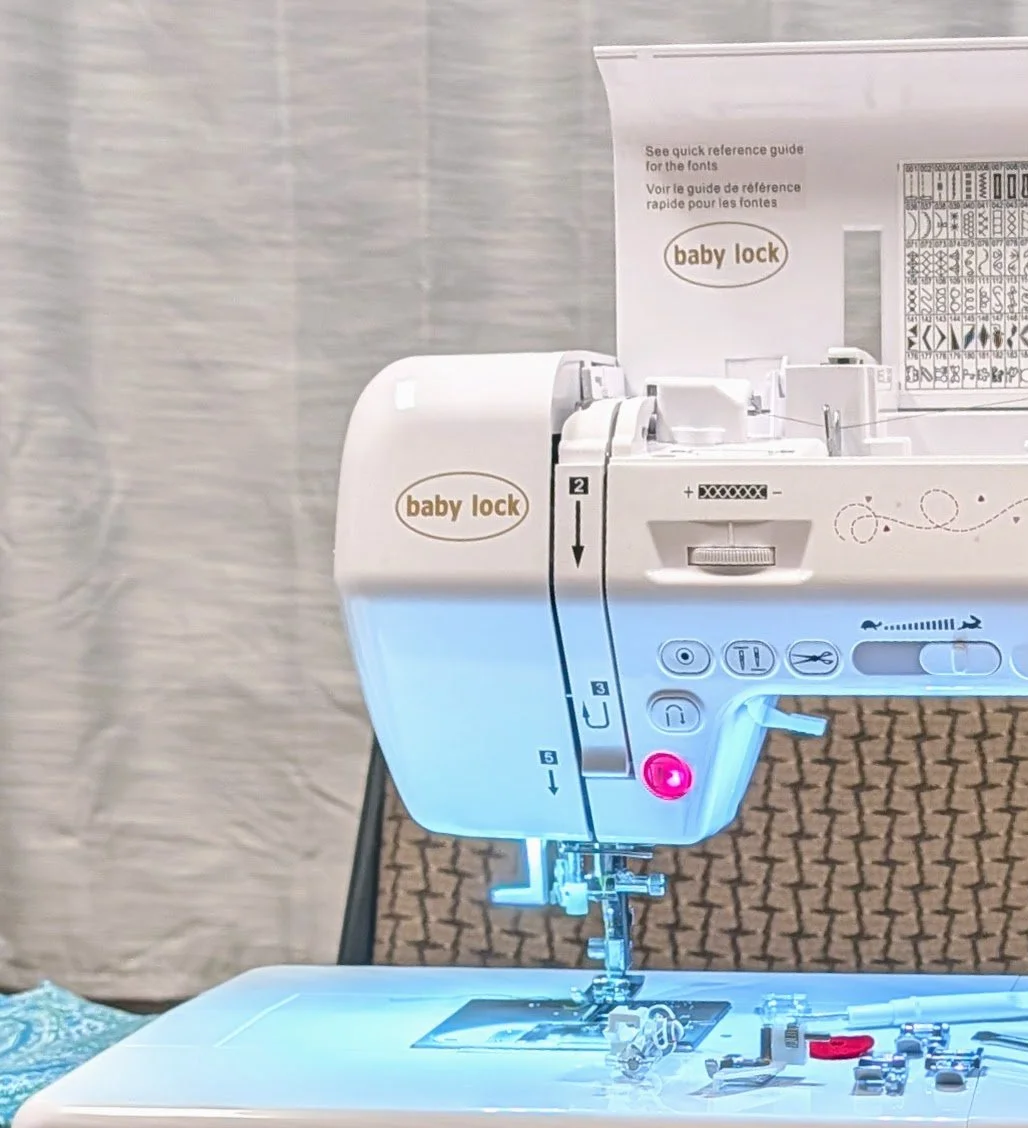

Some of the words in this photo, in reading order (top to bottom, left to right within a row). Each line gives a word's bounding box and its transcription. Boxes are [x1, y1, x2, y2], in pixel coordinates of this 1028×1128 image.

[645, 145, 669, 157] See
[672, 145, 705, 158] quick
[707, 144, 767, 156] reference
[769, 144, 804, 158] guide
[645, 161, 662, 172] for
[665, 160, 684, 172] the
[687, 160, 718, 171] fonts
[646, 183, 671, 195] Voir
[673, 183, 684, 194] le
[687, 183, 721, 196] guide
[723, 182, 739, 193] de
[742, 182, 801, 193] référence
[646, 198, 685, 211] rapide
[688, 200, 716, 211] pour
[718, 198, 736, 209] les
[739, 197, 777, 209] fontes
[674, 245, 725, 269] baby
[735, 242, 780, 264] lock
[406, 494, 463, 521] baby
[472, 493, 520, 517] lock
